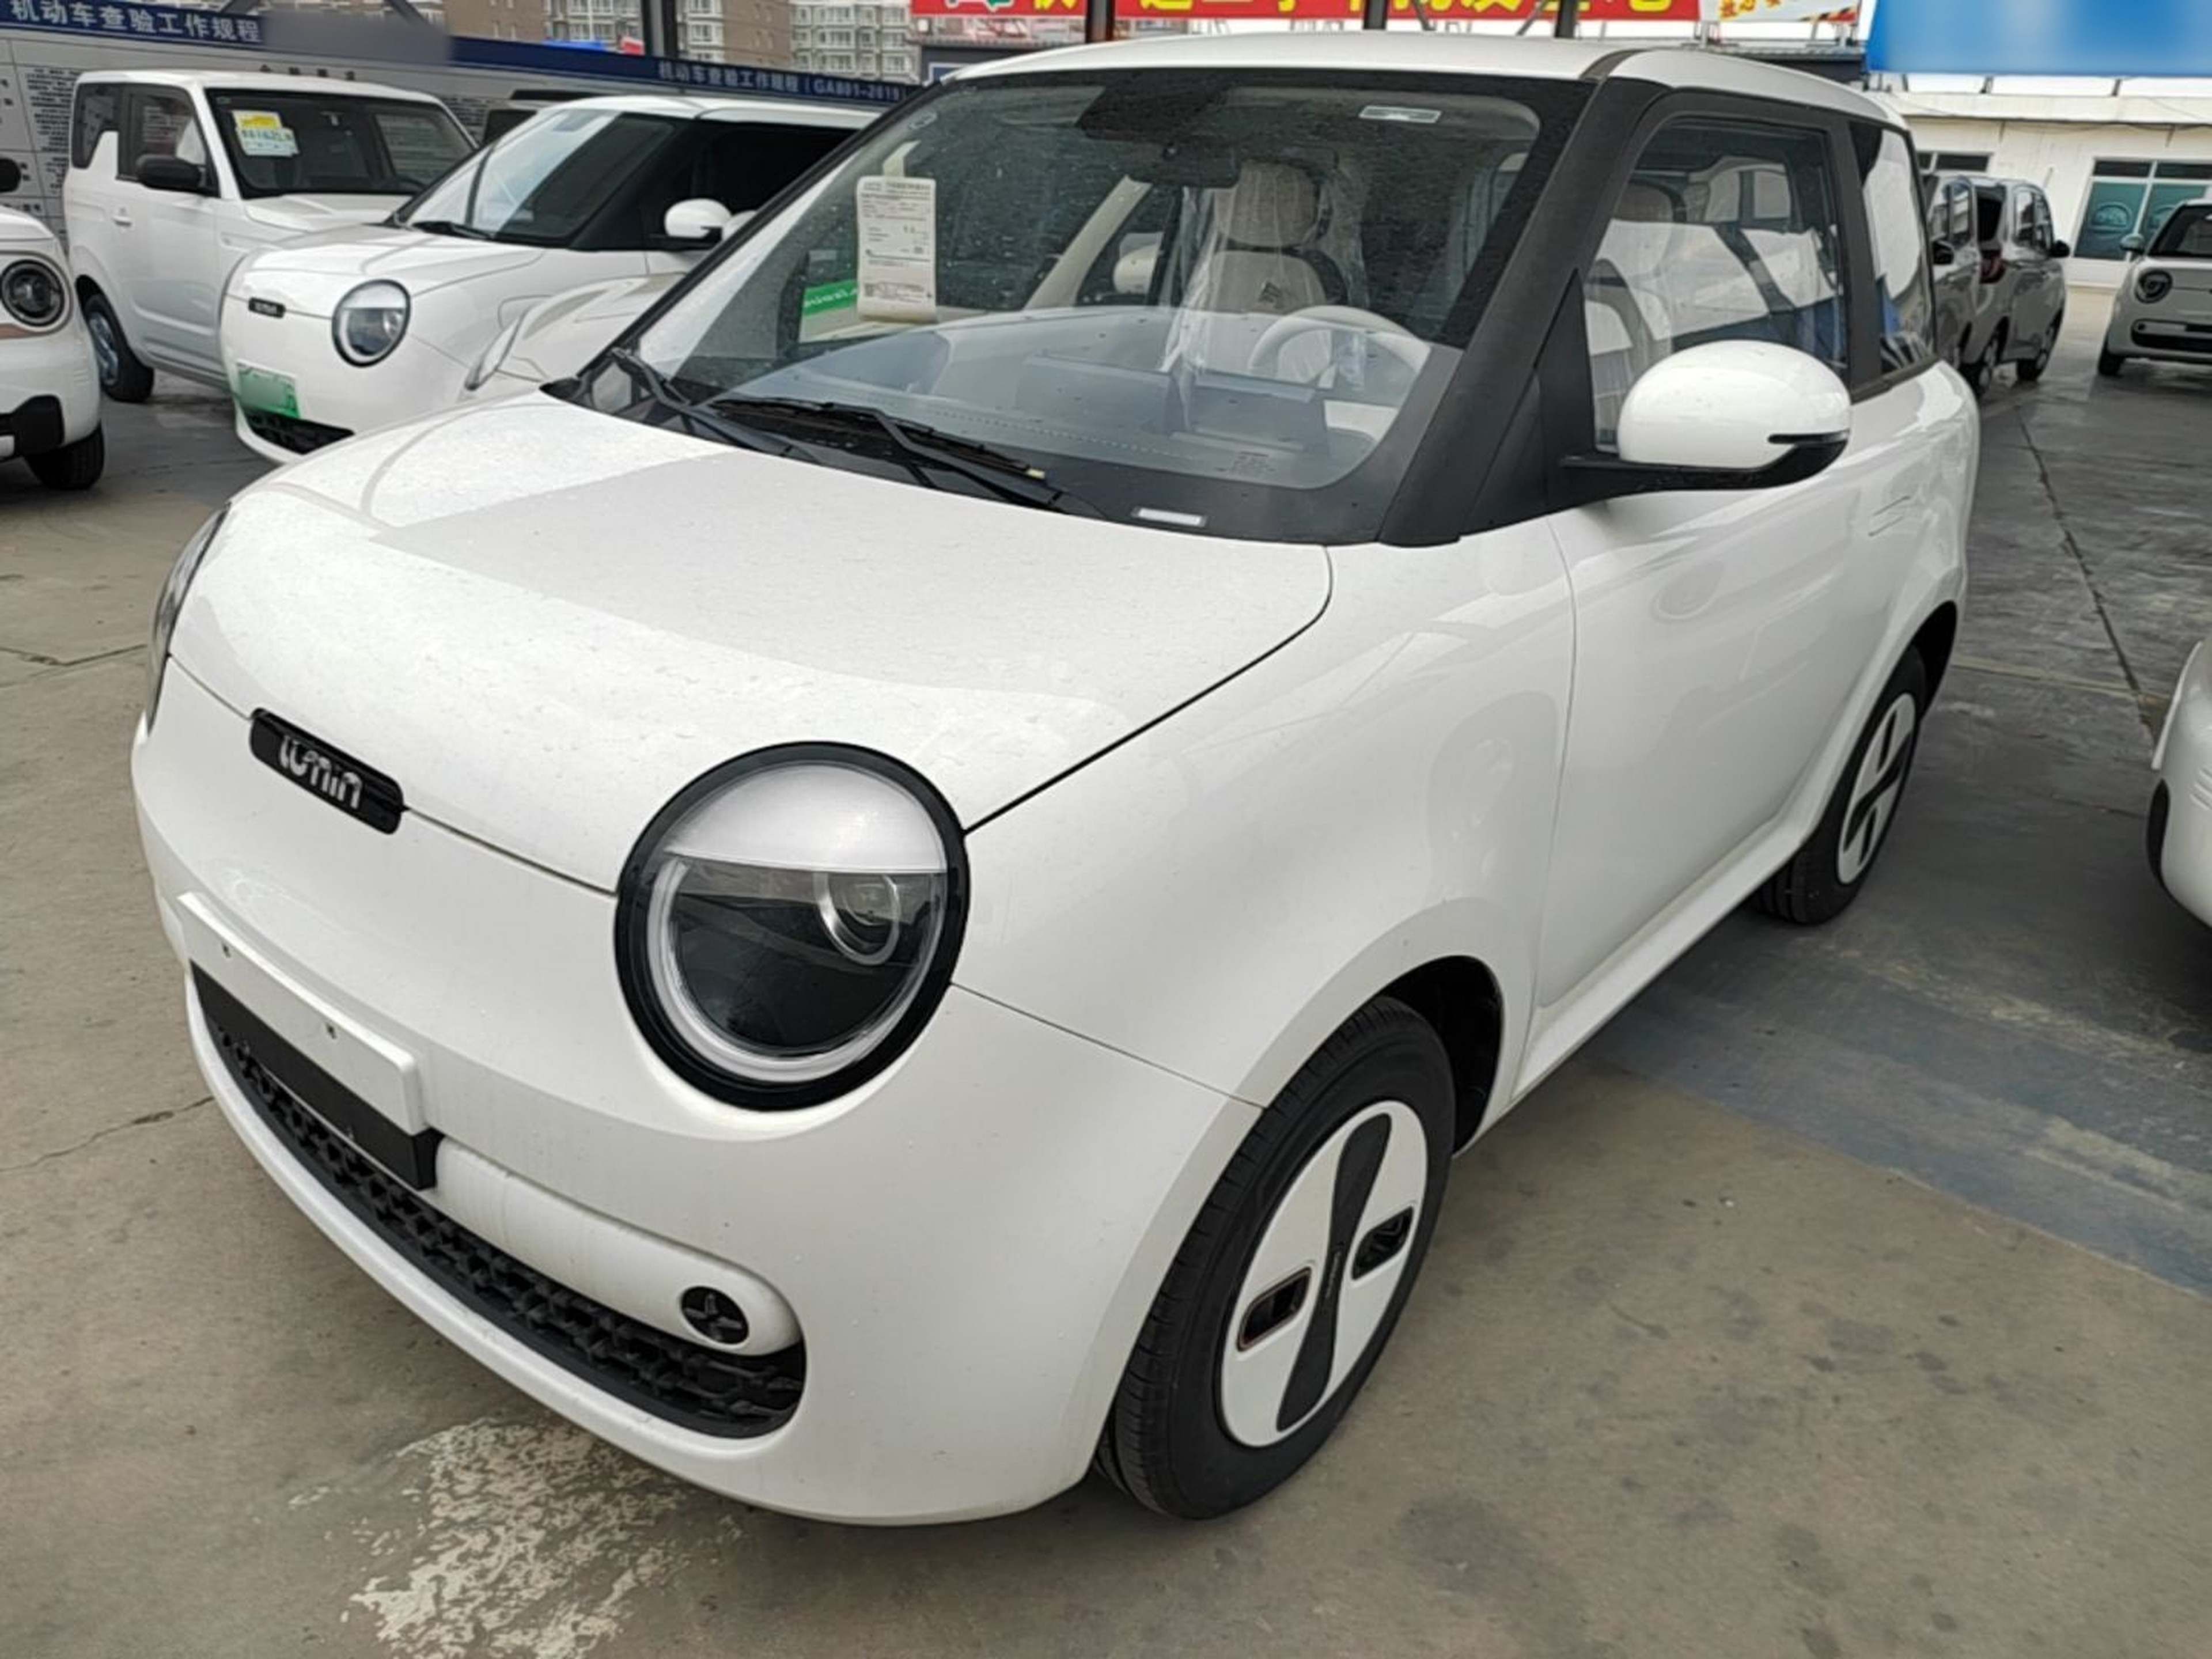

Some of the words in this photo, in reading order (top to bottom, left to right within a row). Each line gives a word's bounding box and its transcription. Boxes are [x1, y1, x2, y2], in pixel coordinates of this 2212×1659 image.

[11, 0, 262, 43] 机动车查验工作规程
